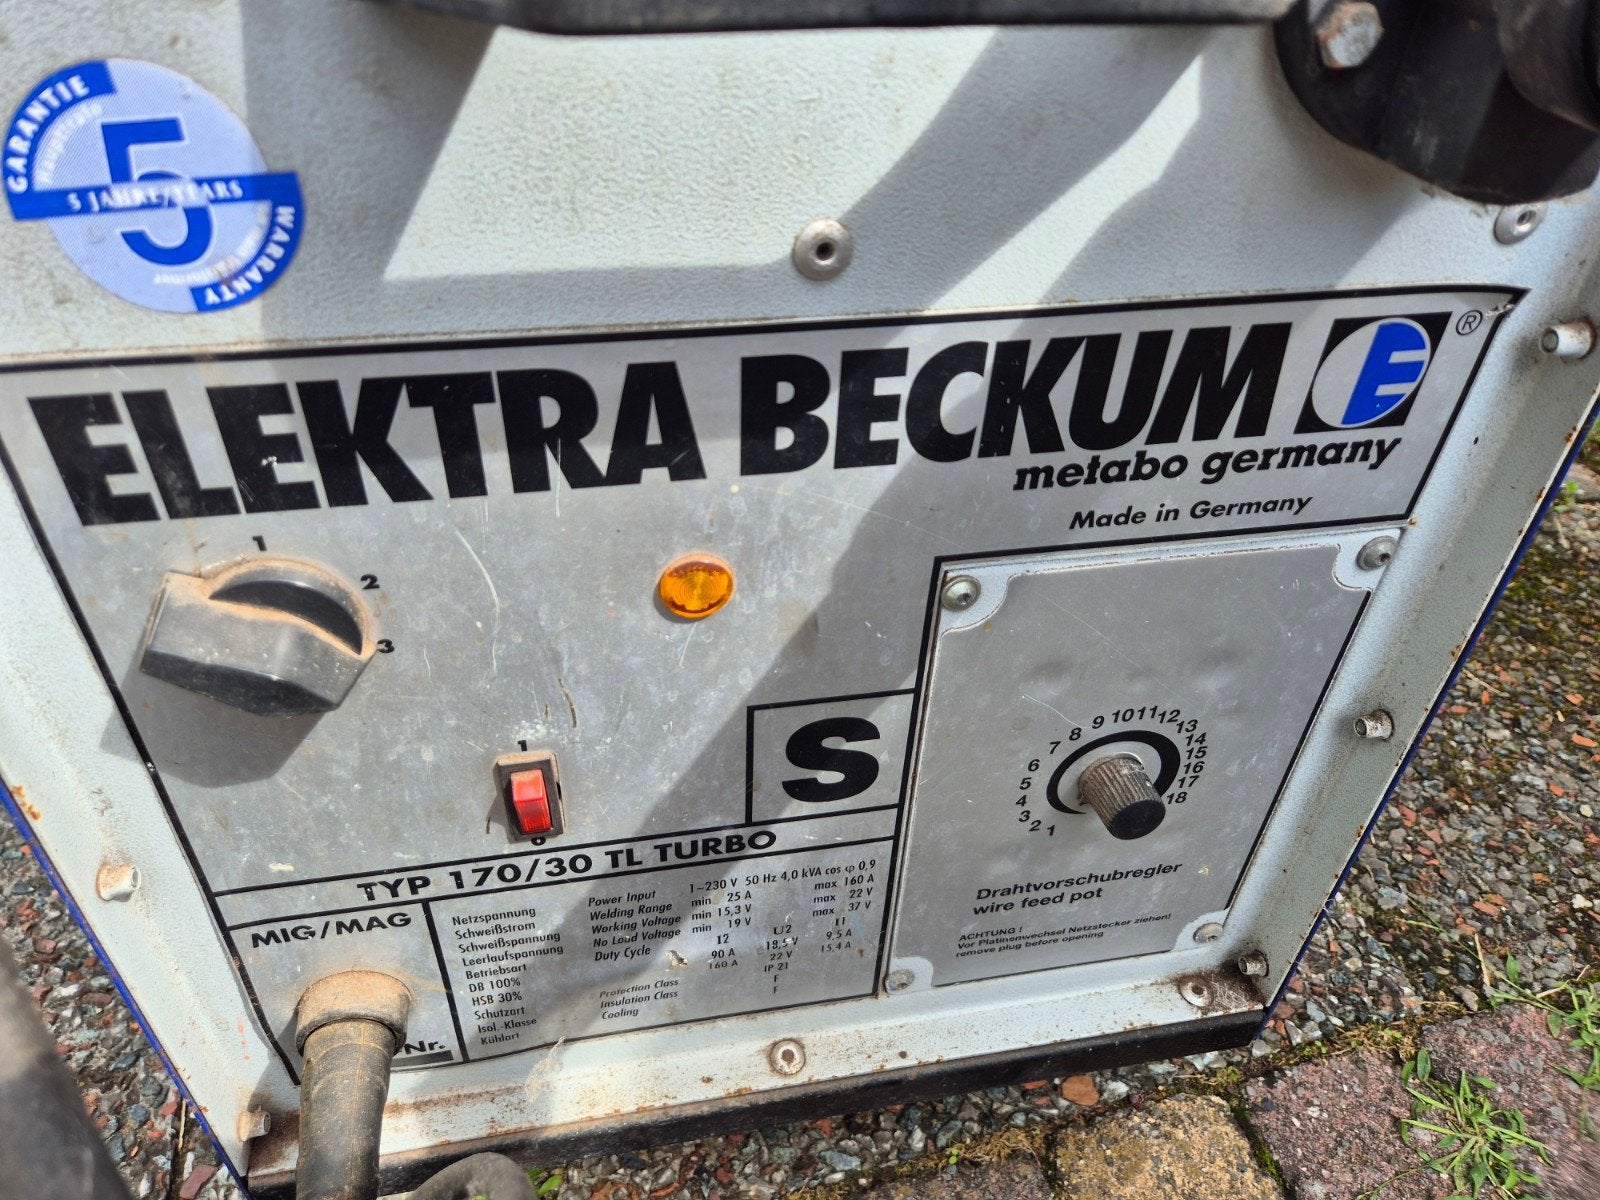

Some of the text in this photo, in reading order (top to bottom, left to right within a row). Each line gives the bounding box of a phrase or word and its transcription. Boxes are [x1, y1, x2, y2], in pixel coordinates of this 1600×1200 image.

[6, 74, 90, 194] GARANTIE
[101, 118, 213, 266] 5
[68, 192, 82, 212] 5
[205, 206, 296, 306] WARRANTY
[27, 322, 1292, 527] ELEKTRA BECKUM
[1014, 434, 1402, 491] metabo germany
[1069, 494, 1313, 530] Made in Germany
[253, 536, 267, 551] 1
[361, 574, 380, 590] 2
[377, 639, 394, 653] 3
[1112, 708, 1134, 724] 10
[1137, 705, 1158, 720] 11
[1158, 709, 1181, 724] 12
[1091, 715, 1105, 730] 9
[1176, 719, 1198, 734] 13
[1068, 728, 1082, 741] 8
[1186, 732, 1208, 746] 14
[518, 740, 527, 752] 1
[1050, 741, 1061, 754] 7
[1186, 746, 1208, 760] 15
[782, 717, 881, 802] S
[1027, 758, 1040, 772] 6
[1183, 760, 1204, 774] 16
[1019, 778, 1032, 790] 5
[1178, 775, 1200, 788] 17
[1015, 796, 1027, 807] 4
[1166, 791, 1187, 804] 18
[1018, 810, 1030, 822] 3
[1029, 820, 1042, 832] 2
[1047, 824, 1056, 836] 1
[357, 830, 777, 902] TYP 170/30 TL TURBO
[731, 878, 738, 887] V
[746, 875, 759, 886] 50
[763, 874, 776, 882] Hz
[780, 870, 798, 882] 4,0
[802, 866, 822, 878] kVA
[858, 860, 876, 871] 0,9
[814, 874, 874, 890] max 160 A
[976, 862, 1184, 900] Drahtvorschubregler
[588, 890, 656, 907] Power Input
[692, 890, 752, 906] min 25 A
[814, 887, 873, 904] max 22 V
[972, 888, 1104, 916] wire feed pot
[590, 903, 672, 920] Welding Range
[692, 904, 752, 920] min 15,3 V
[812, 901, 872, 917] max 37 V
[452, 908, 536, 926] Netzspannung
[252, 912, 412, 948] MIG/MAG
[455, 922, 536, 940] Schweißstrom
[592, 916, 681, 934] Working Voltage
[692, 918, 751, 934] min 19 V
[773, 924, 792, 935] U2
[978, 928, 1066, 945] Platinenwechsel
[1068, 920, 1130, 933] Netzstecker
[1134, 913, 1172, 924] ziehen!
[593, 928, 681, 948] No Load Voltage
[792, 936, 798, 946] V
[958, 928, 1016, 942] ACHTUNG
[458, 932, 560, 954] Schweißspannung
[956, 932, 1104, 958] remove plug before opening
[462, 946, 564, 966] Leerlaufspannung
[594, 945, 650, 961] Duty Cycle
[712, 948, 735, 958] 90 A
[770, 950, 793, 961] 22 V
[466, 963, 527, 980] Betriebsart
[709, 961, 728, 970] 160
[764, 962, 788, 972] IP 21
[469, 977, 520, 992] DB 100%
[774, 974, 780, 982] F
[600, 980, 678, 998] Protection Class
[773, 986, 779, 994] F
[472, 991, 522, 1006] HSB 30%
[600, 990, 678, 1008] Insulation Class
[475, 1006, 525, 1020] Schutzart
[602, 1008, 638, 1020] Cooling
[478, 1018, 537, 1033] Isol.-Klasse
[480, 1032, 519, 1045] Kühlart
